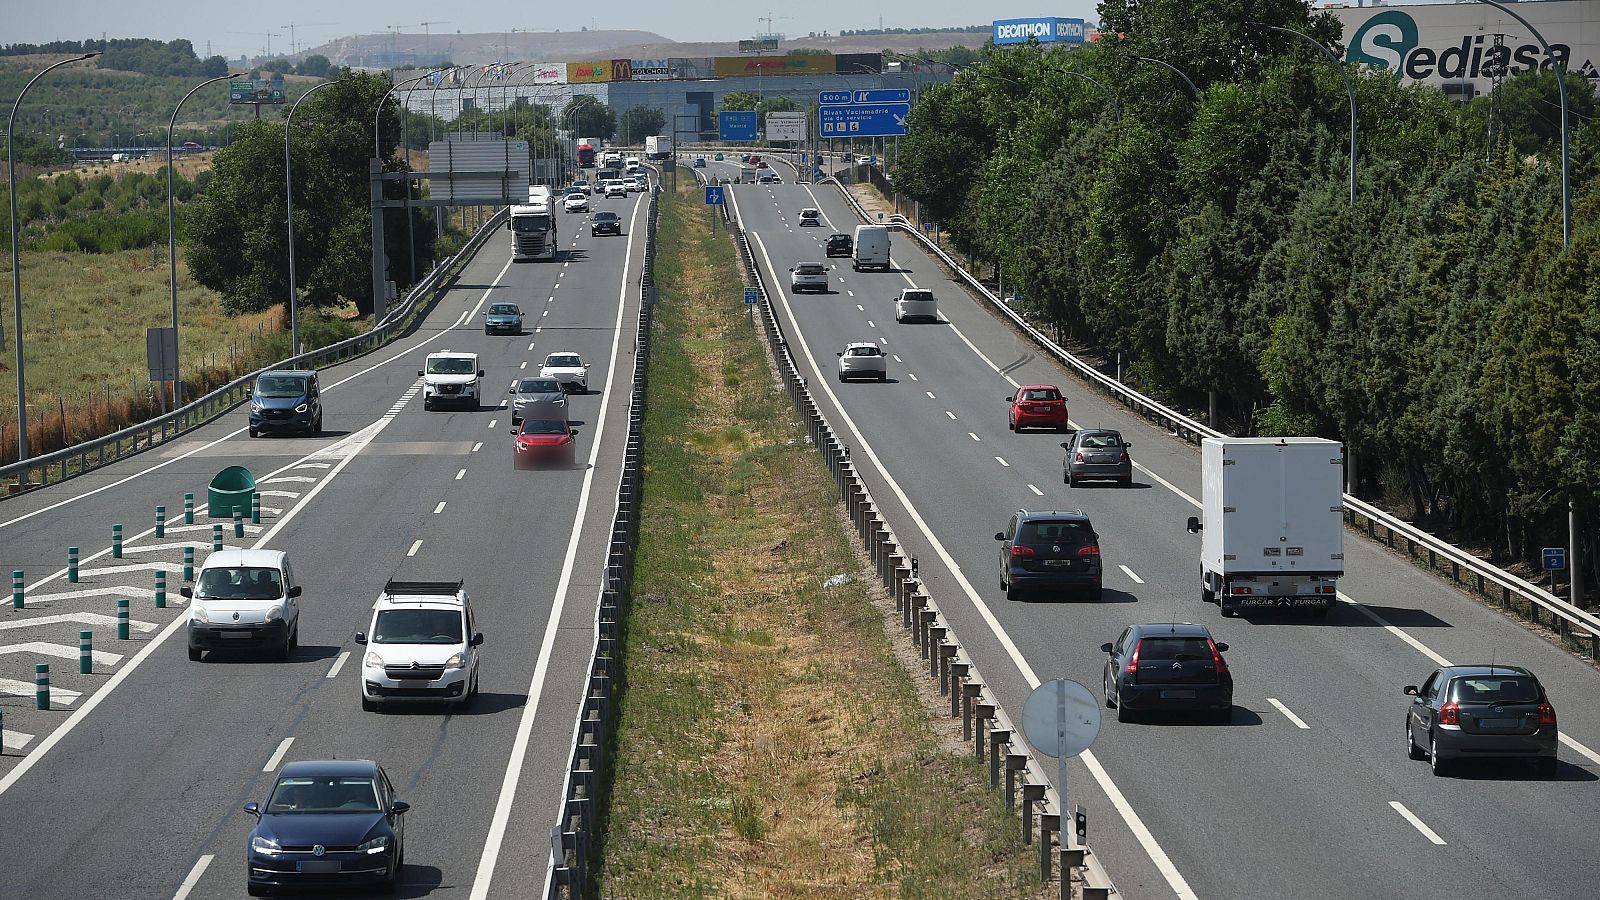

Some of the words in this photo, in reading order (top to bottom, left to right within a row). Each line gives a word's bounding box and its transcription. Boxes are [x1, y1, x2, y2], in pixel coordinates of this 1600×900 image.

[998, 22, 1051, 38] DECATHLON
[1056, 22, 1083, 37] DECATHLON
[1358, 20, 1571, 79] Sediasa
[632, 59, 667, 67] MAX
[1551, 558, 1558, 566] 2
